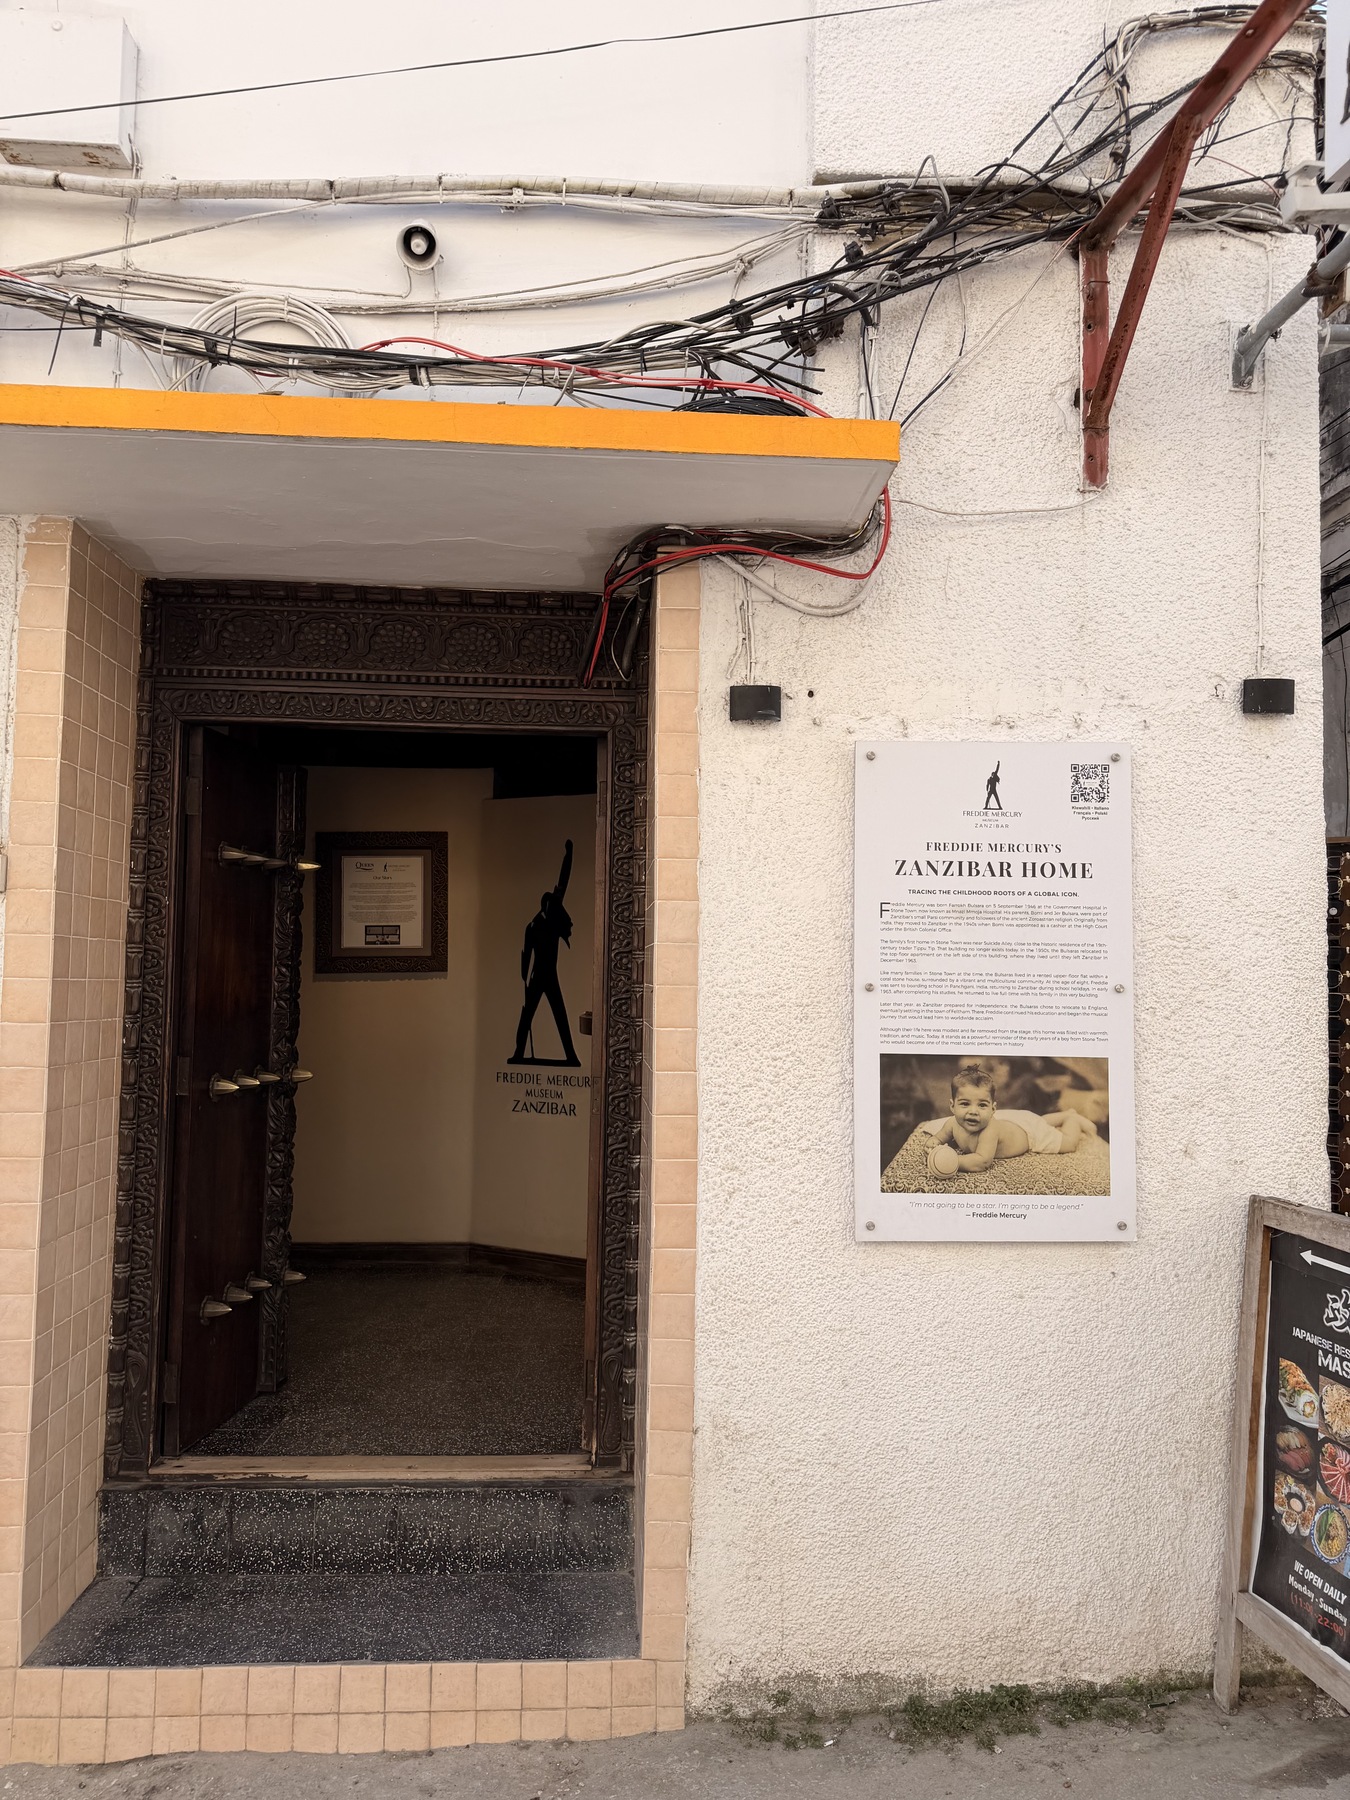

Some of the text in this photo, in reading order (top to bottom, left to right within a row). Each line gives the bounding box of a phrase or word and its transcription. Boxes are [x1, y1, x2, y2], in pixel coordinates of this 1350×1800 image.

[926, 842, 1062, 854] FREDDIE MERCURY'S
[895, 859, 1093, 879] ZANZIBAR HOME
[496, 1072, 591, 1088] FREDDIE MERCUR
[525, 1089, 564, 1099] MUSEUM
[512, 1100, 577, 1116] ZANZIBAR
[936, 1202, 956, 1210] going
[999, 1212, 1027, 1220] Mercury
[1291, 1327, 1329, 1352] JAPANESE
[1294, 1560, 1347, 1605] WE OPEN DAILY
[1289, 1574, 1315, 1602] Monday
[1319, 1598, 1347, 1626] Sunday
